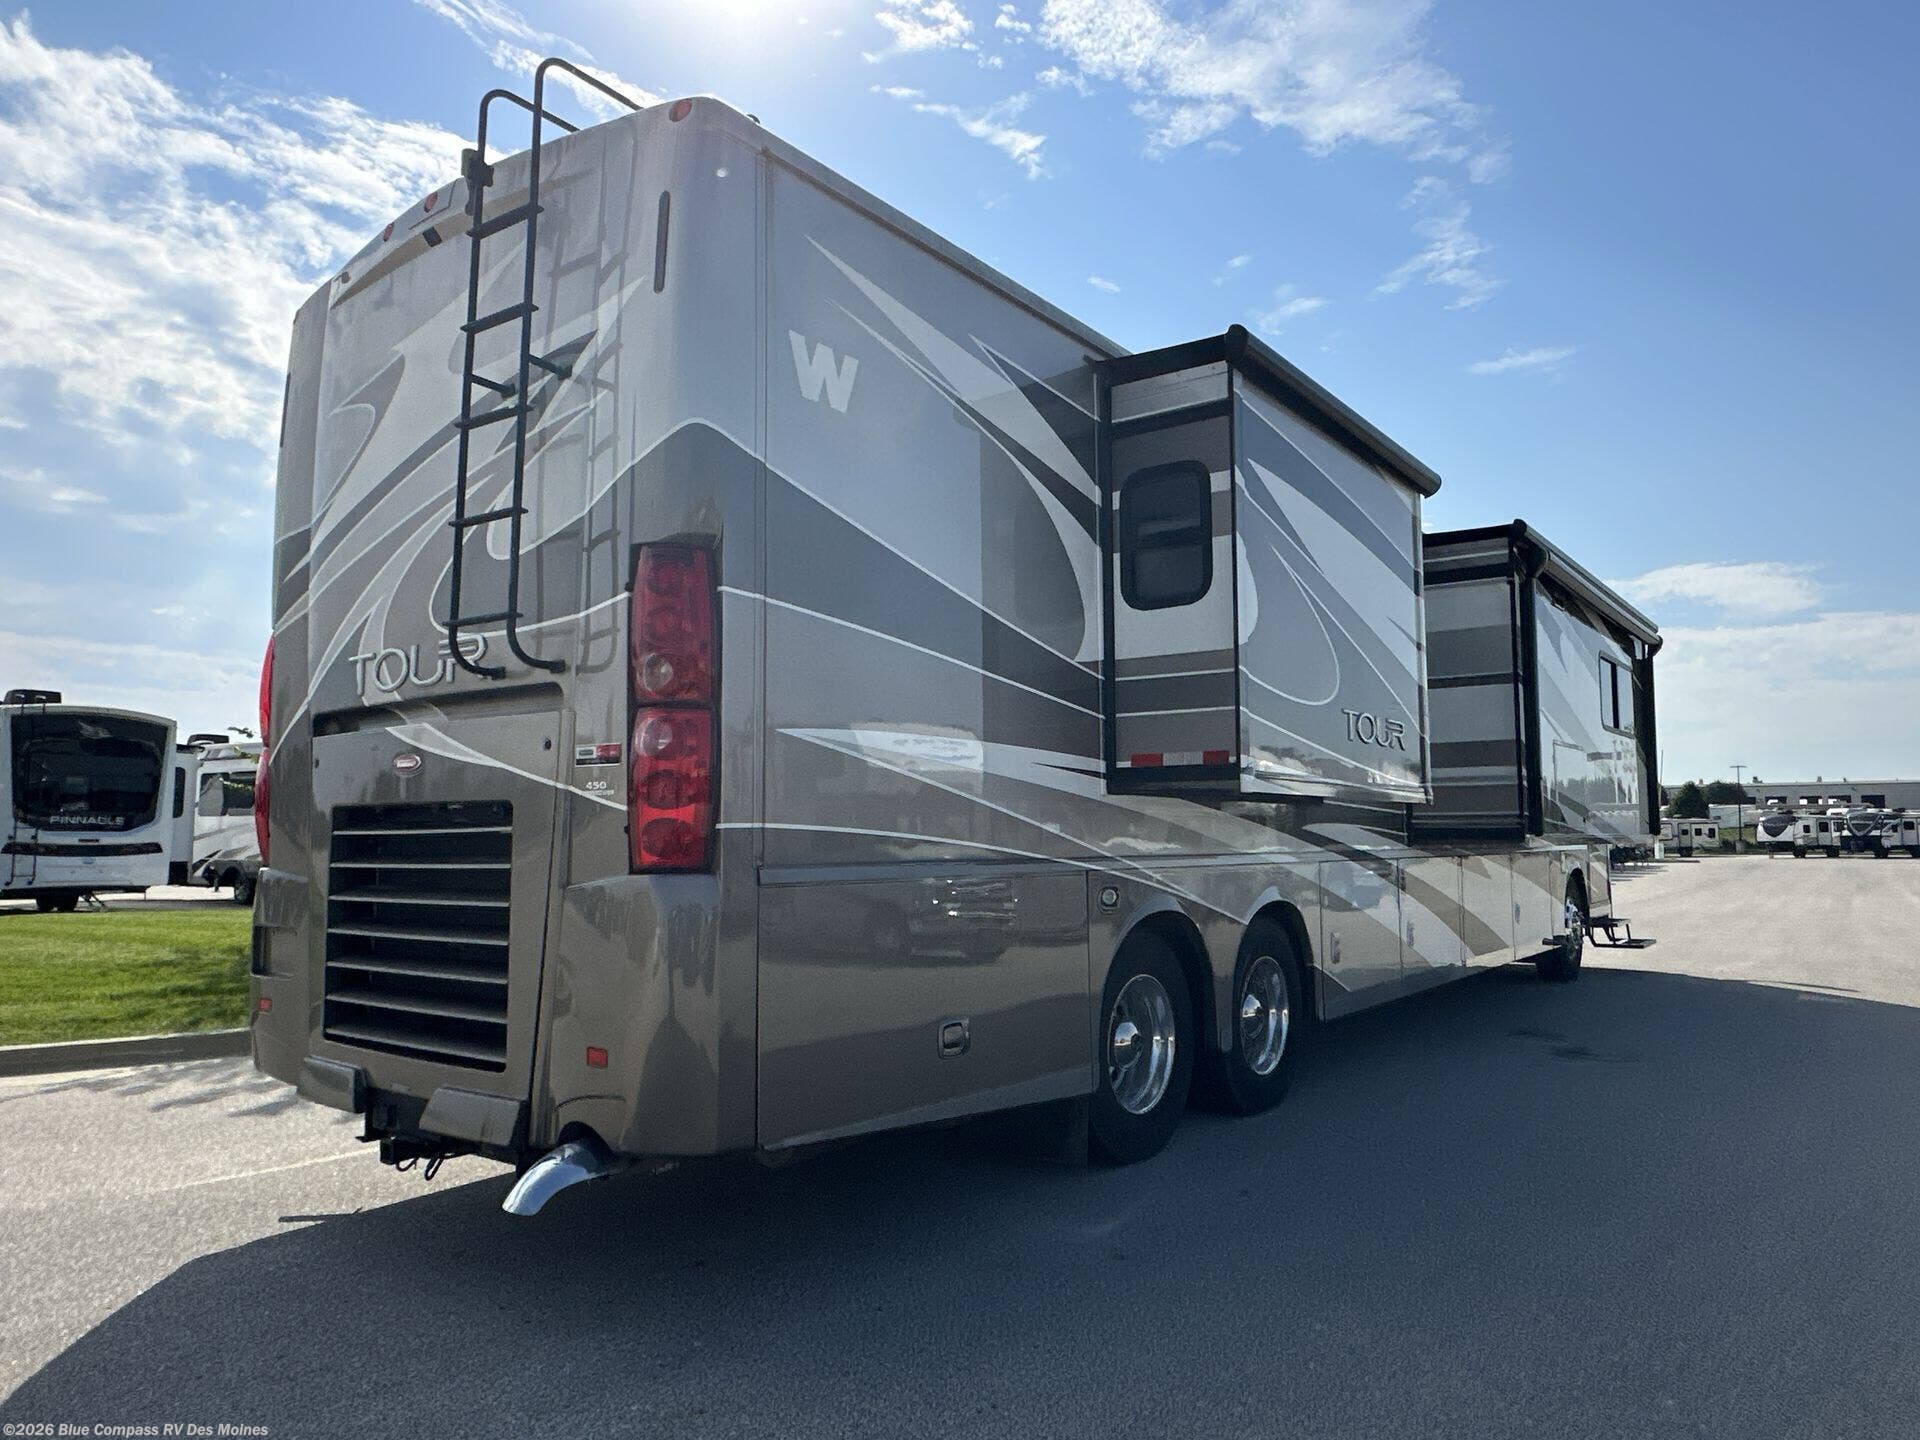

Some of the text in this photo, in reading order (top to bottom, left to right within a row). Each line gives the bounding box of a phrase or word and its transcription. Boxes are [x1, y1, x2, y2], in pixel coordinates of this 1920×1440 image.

[348, 633, 489, 696] TOUR
[1340, 708, 1406, 751] TOUR
[586, 781, 607, 790] 450
[49, 815, 125, 826] PINNACLE
